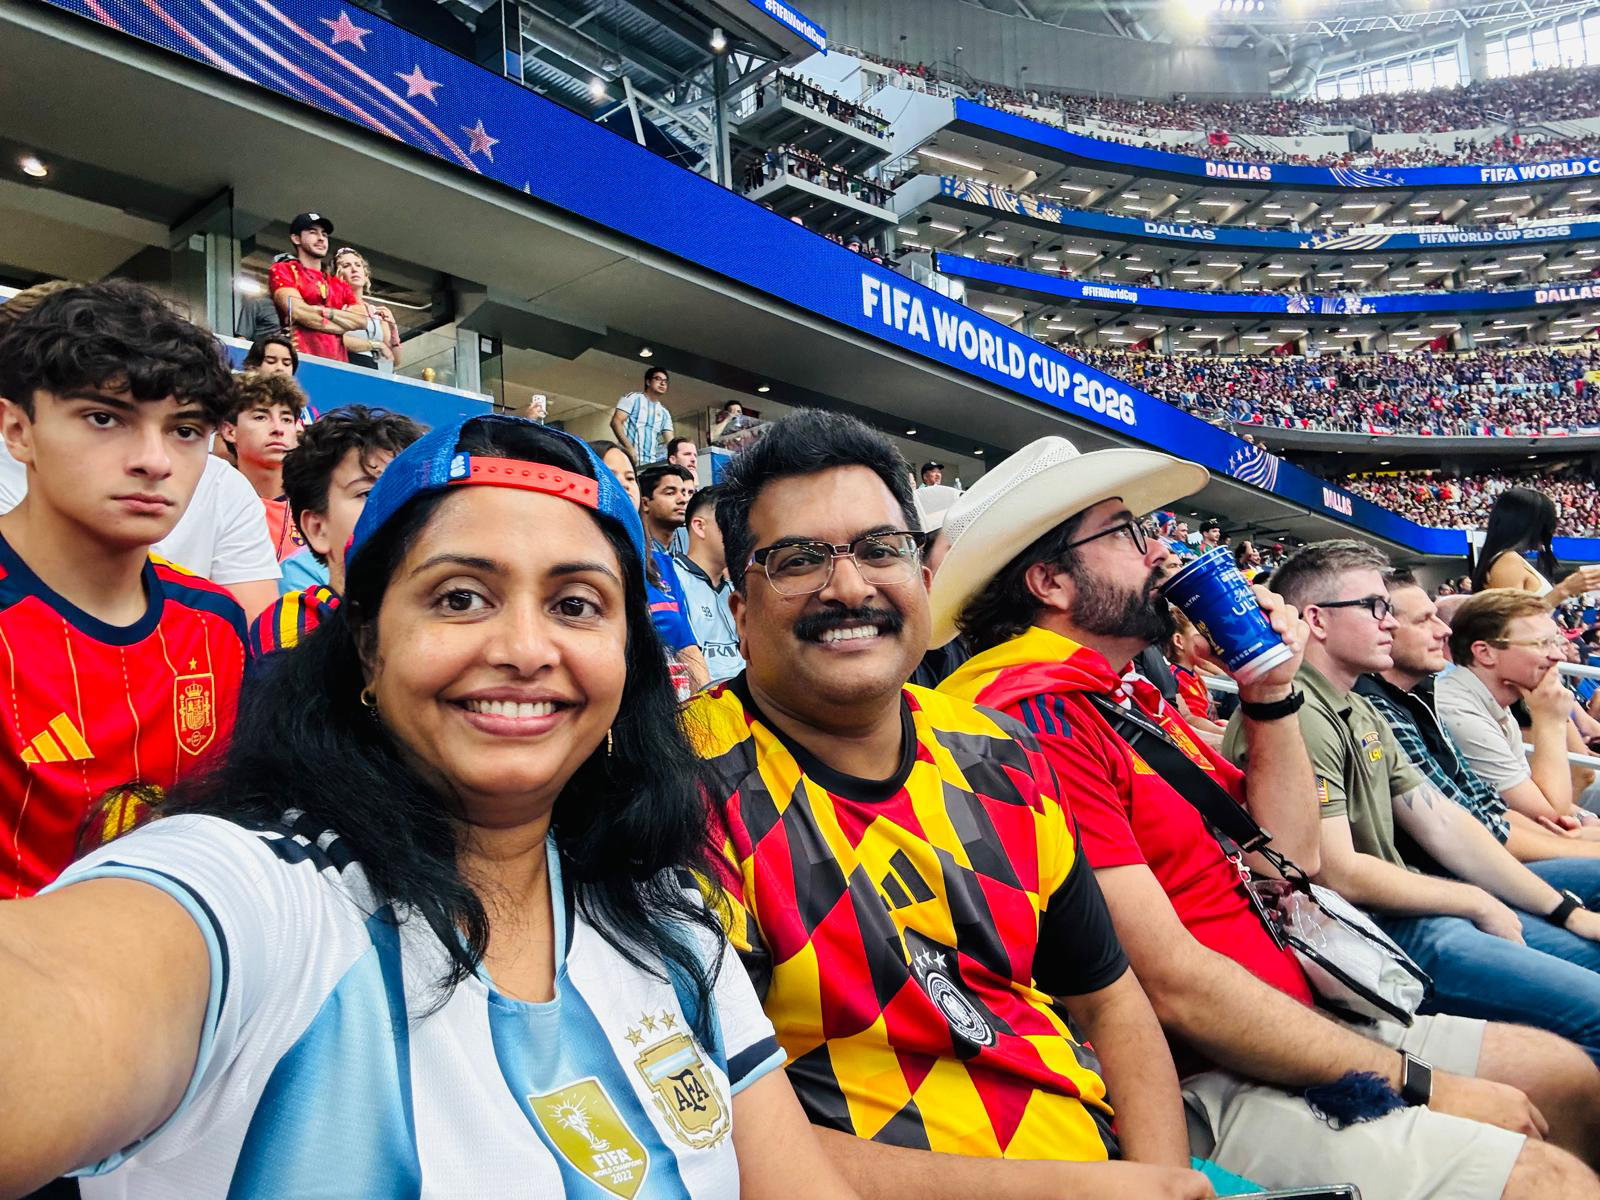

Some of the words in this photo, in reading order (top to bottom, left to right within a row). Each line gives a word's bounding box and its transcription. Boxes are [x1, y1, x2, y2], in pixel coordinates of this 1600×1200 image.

[1205, 161, 1272, 180] DALLAS
[1480, 167, 1519, 182] FIFA
[1519, 161, 1586, 180] WORLD
[1144, 222, 1217, 240] DALLAS
[1419, 233, 1447, 244] FIFA
[1446, 231, 1493, 243] WORLD
[1494, 230, 1522, 241] CUP
[1522, 225, 1571, 239] 2026
[1081, 285, 1138, 303] #FIFAWorldCup
[1535, 285, 1600, 303] DALLAS
[861, 273, 931, 343] FIFA
[931, 306, 1026, 380] WORLD
[1028, 352, 1070, 398] CUP
[1072, 372, 1137, 427] 2026
[1322, 486, 1353, 517] DALLAS
[592, 1148, 633, 1169] FIFA
[610, 1169, 635, 1185] 2022
